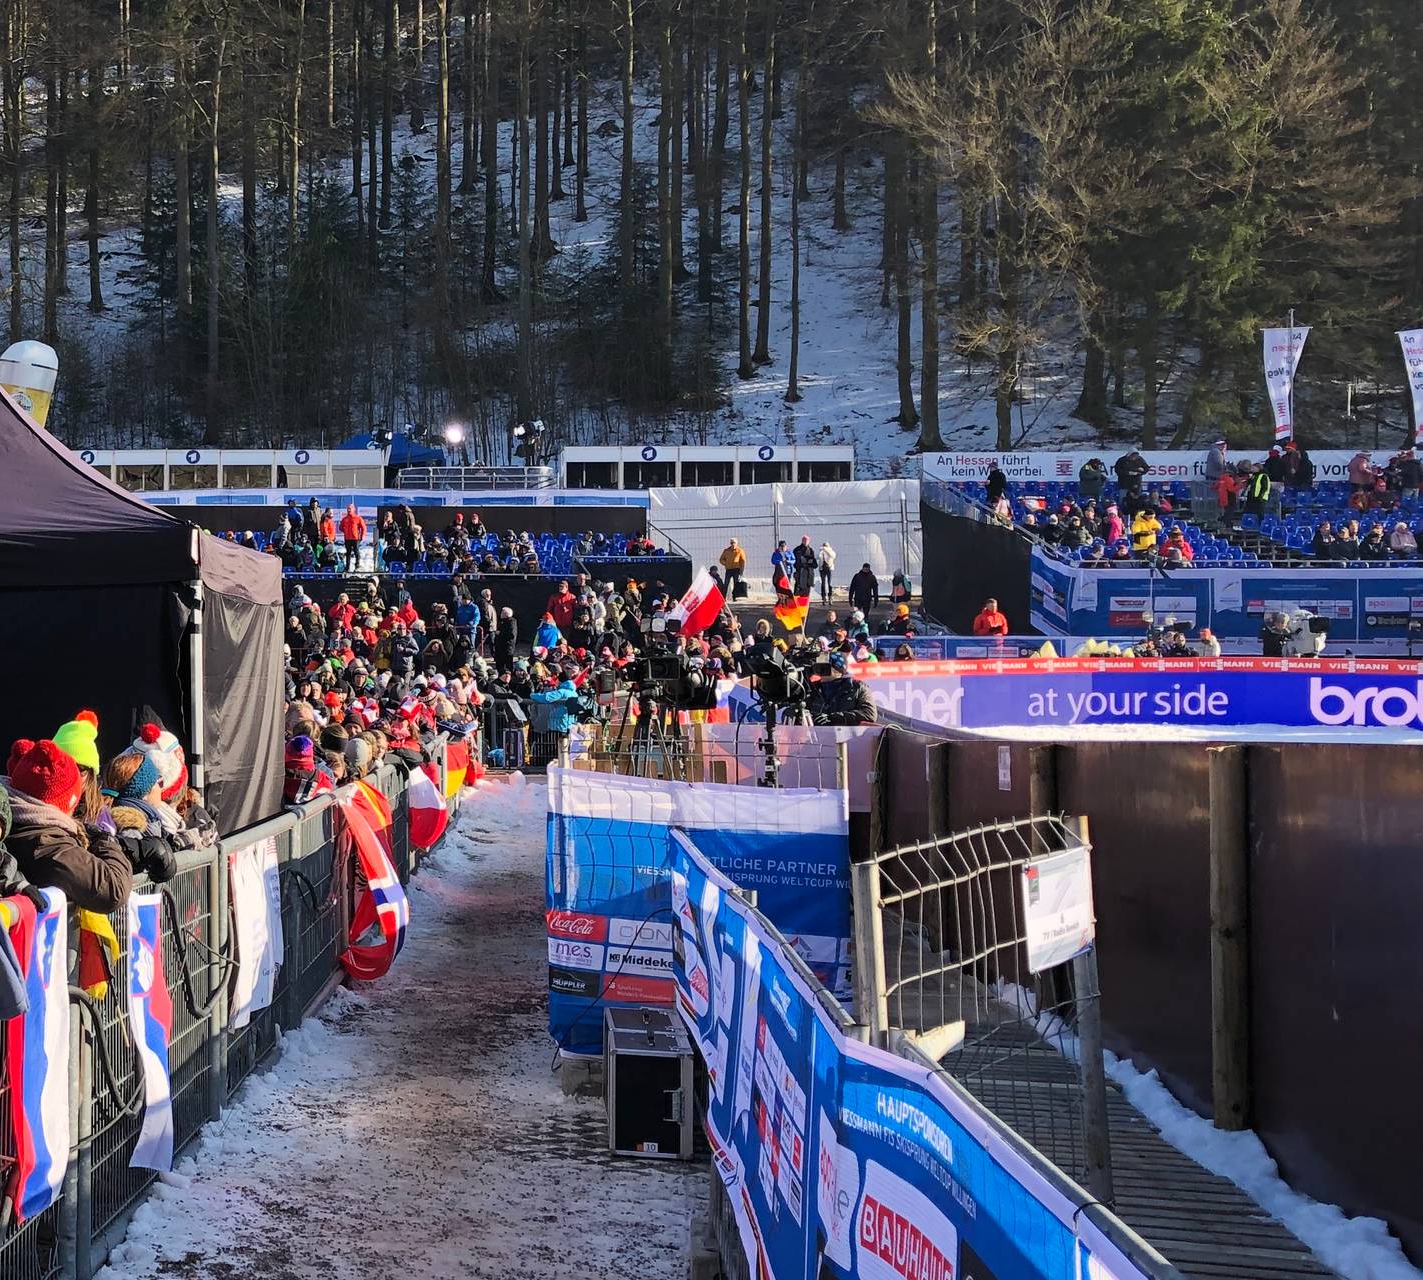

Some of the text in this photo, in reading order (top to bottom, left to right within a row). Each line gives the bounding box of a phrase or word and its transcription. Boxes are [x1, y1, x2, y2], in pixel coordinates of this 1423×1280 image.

[937, 455, 1031, 466] An Hessen führt
[951, 466, 976, 477] kein
[1005, 466, 1045, 477] vorbei.
[872, 681, 964, 726] other
[1028, 687, 1058, 717] at
[1067, 691, 1148, 724] your
[1154, 683, 1229, 716] side
[709, 856, 838, 876] TLICHE PARTNER
[723, 872, 778, 884] KISPRUNG
[781, 876, 832, 888] WELTCUP
[839, 1106, 883, 1140] VIESSMANN
[883, 1126, 895, 1147] FIS
[646, 1143, 657, 1151] 10
